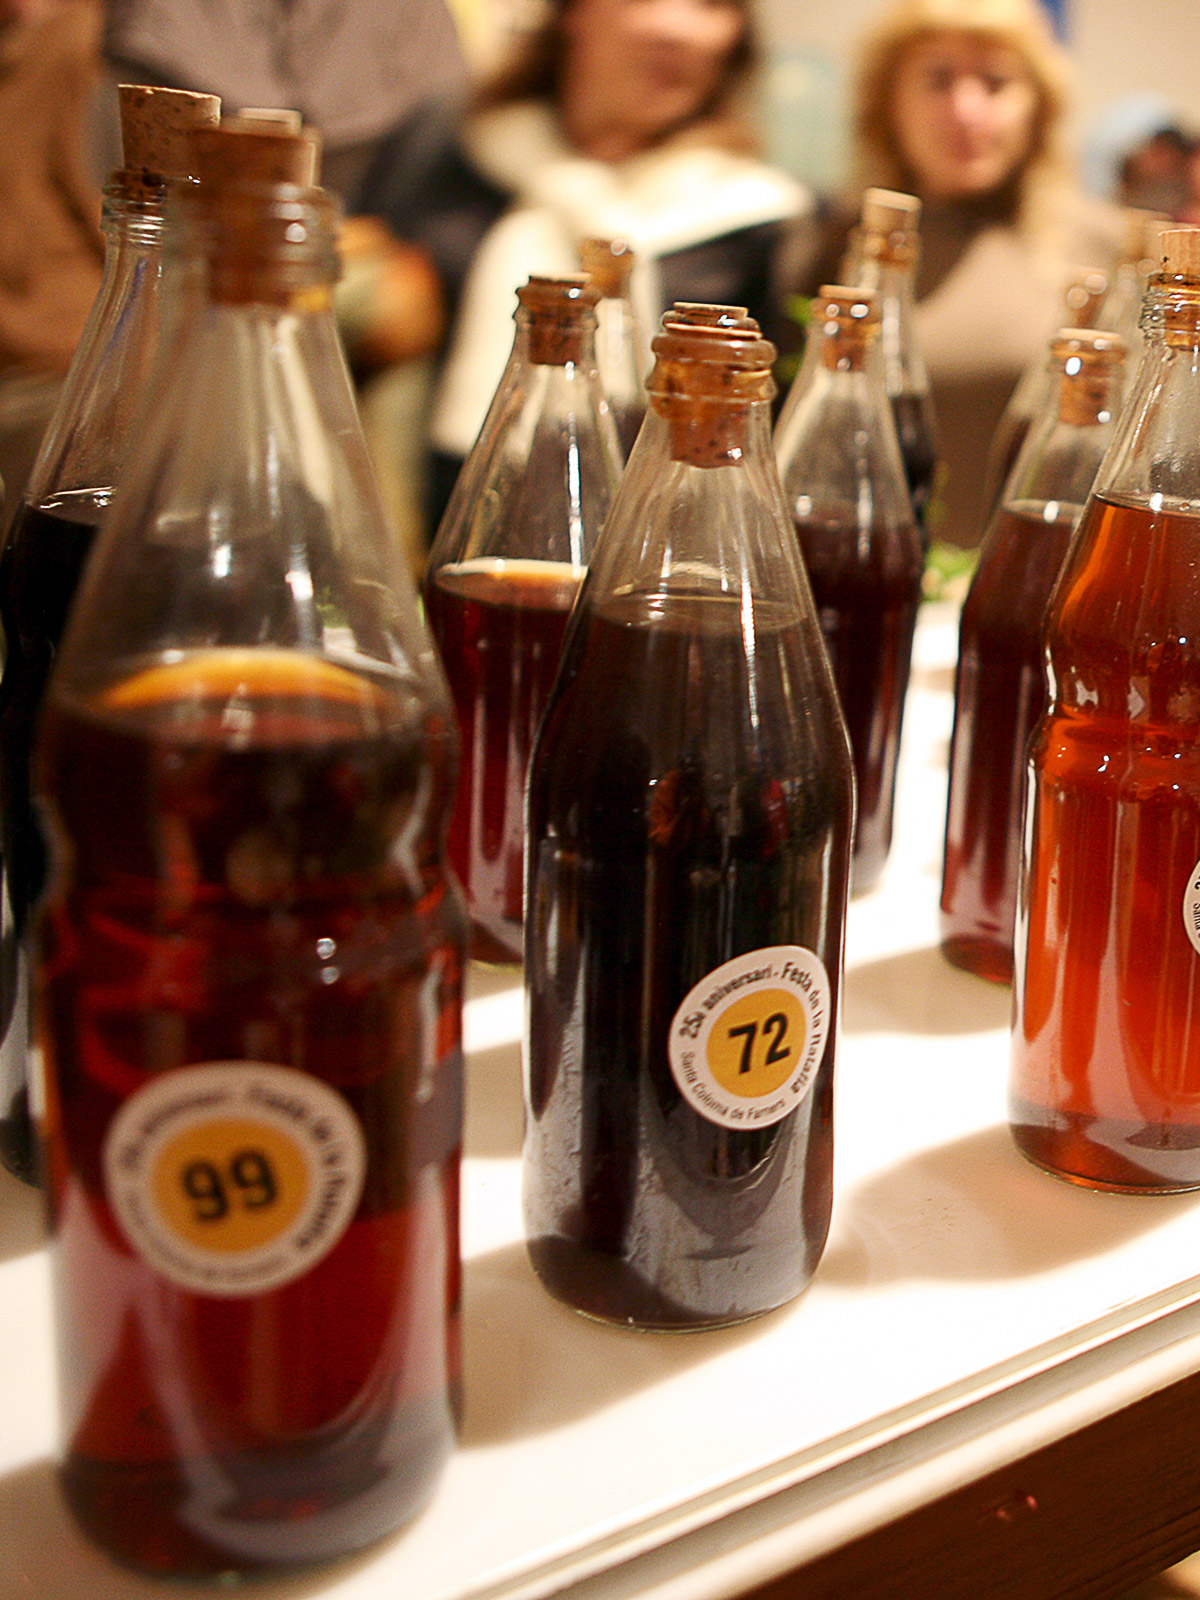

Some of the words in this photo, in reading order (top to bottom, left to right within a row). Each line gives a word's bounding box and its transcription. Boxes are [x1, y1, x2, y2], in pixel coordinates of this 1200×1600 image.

[703, 963, 773, 1011] aniversari
[727, 1011, 792, 1076] 72
[680, 1051, 697, 1083] Santa
[692, 1081, 728, 1116] Coloma
[180, 1148, 278, 1223] 99
